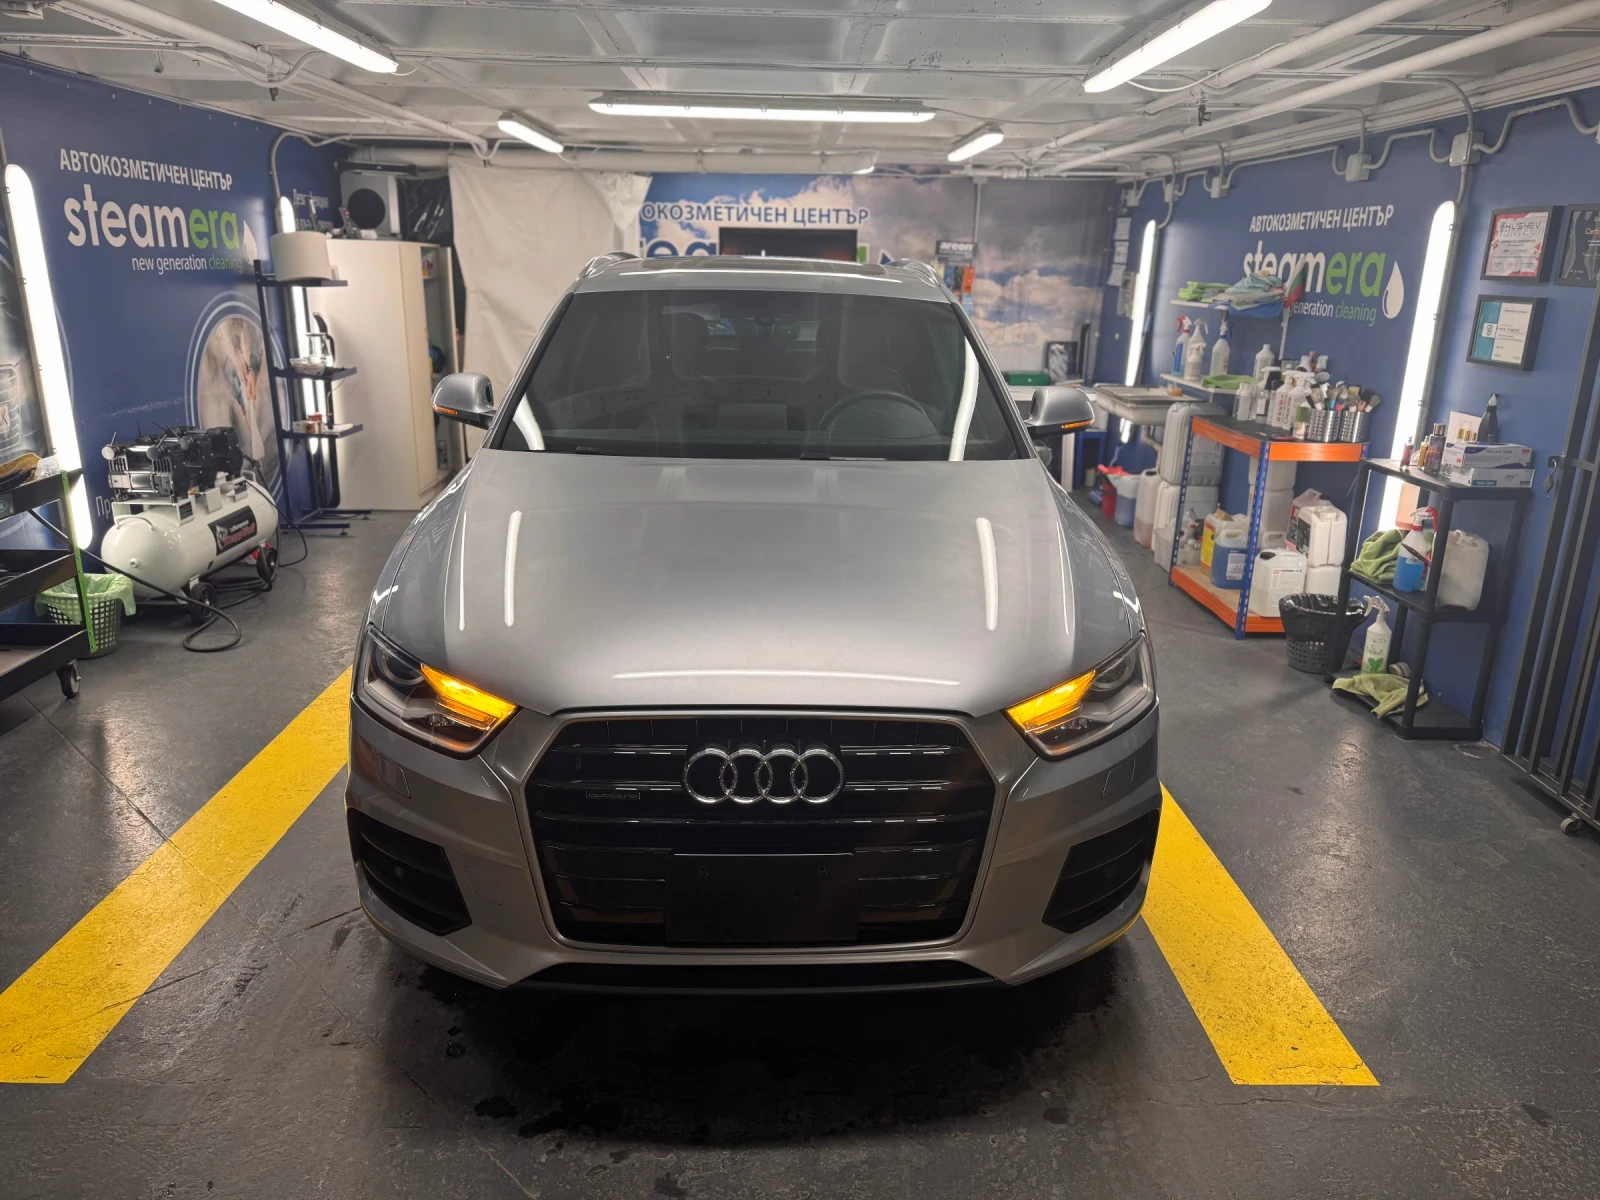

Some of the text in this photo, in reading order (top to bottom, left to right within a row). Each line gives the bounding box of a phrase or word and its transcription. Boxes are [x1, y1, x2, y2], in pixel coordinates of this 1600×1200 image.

[60, 148, 233, 191] АВТОКОЗМЕТИЧЕН ЦЕНТЪР
[63, 183, 241, 249] steamera
[793, 206, 869, 227] ЦЕНТЪР
[1249, 204, 1395, 233] АВТОКОЗМЕТИЧЕН ЦЕНТЪР
[132, 254, 243, 275] new generation cleaning
[1335, 301, 1377, 327] cleaning
